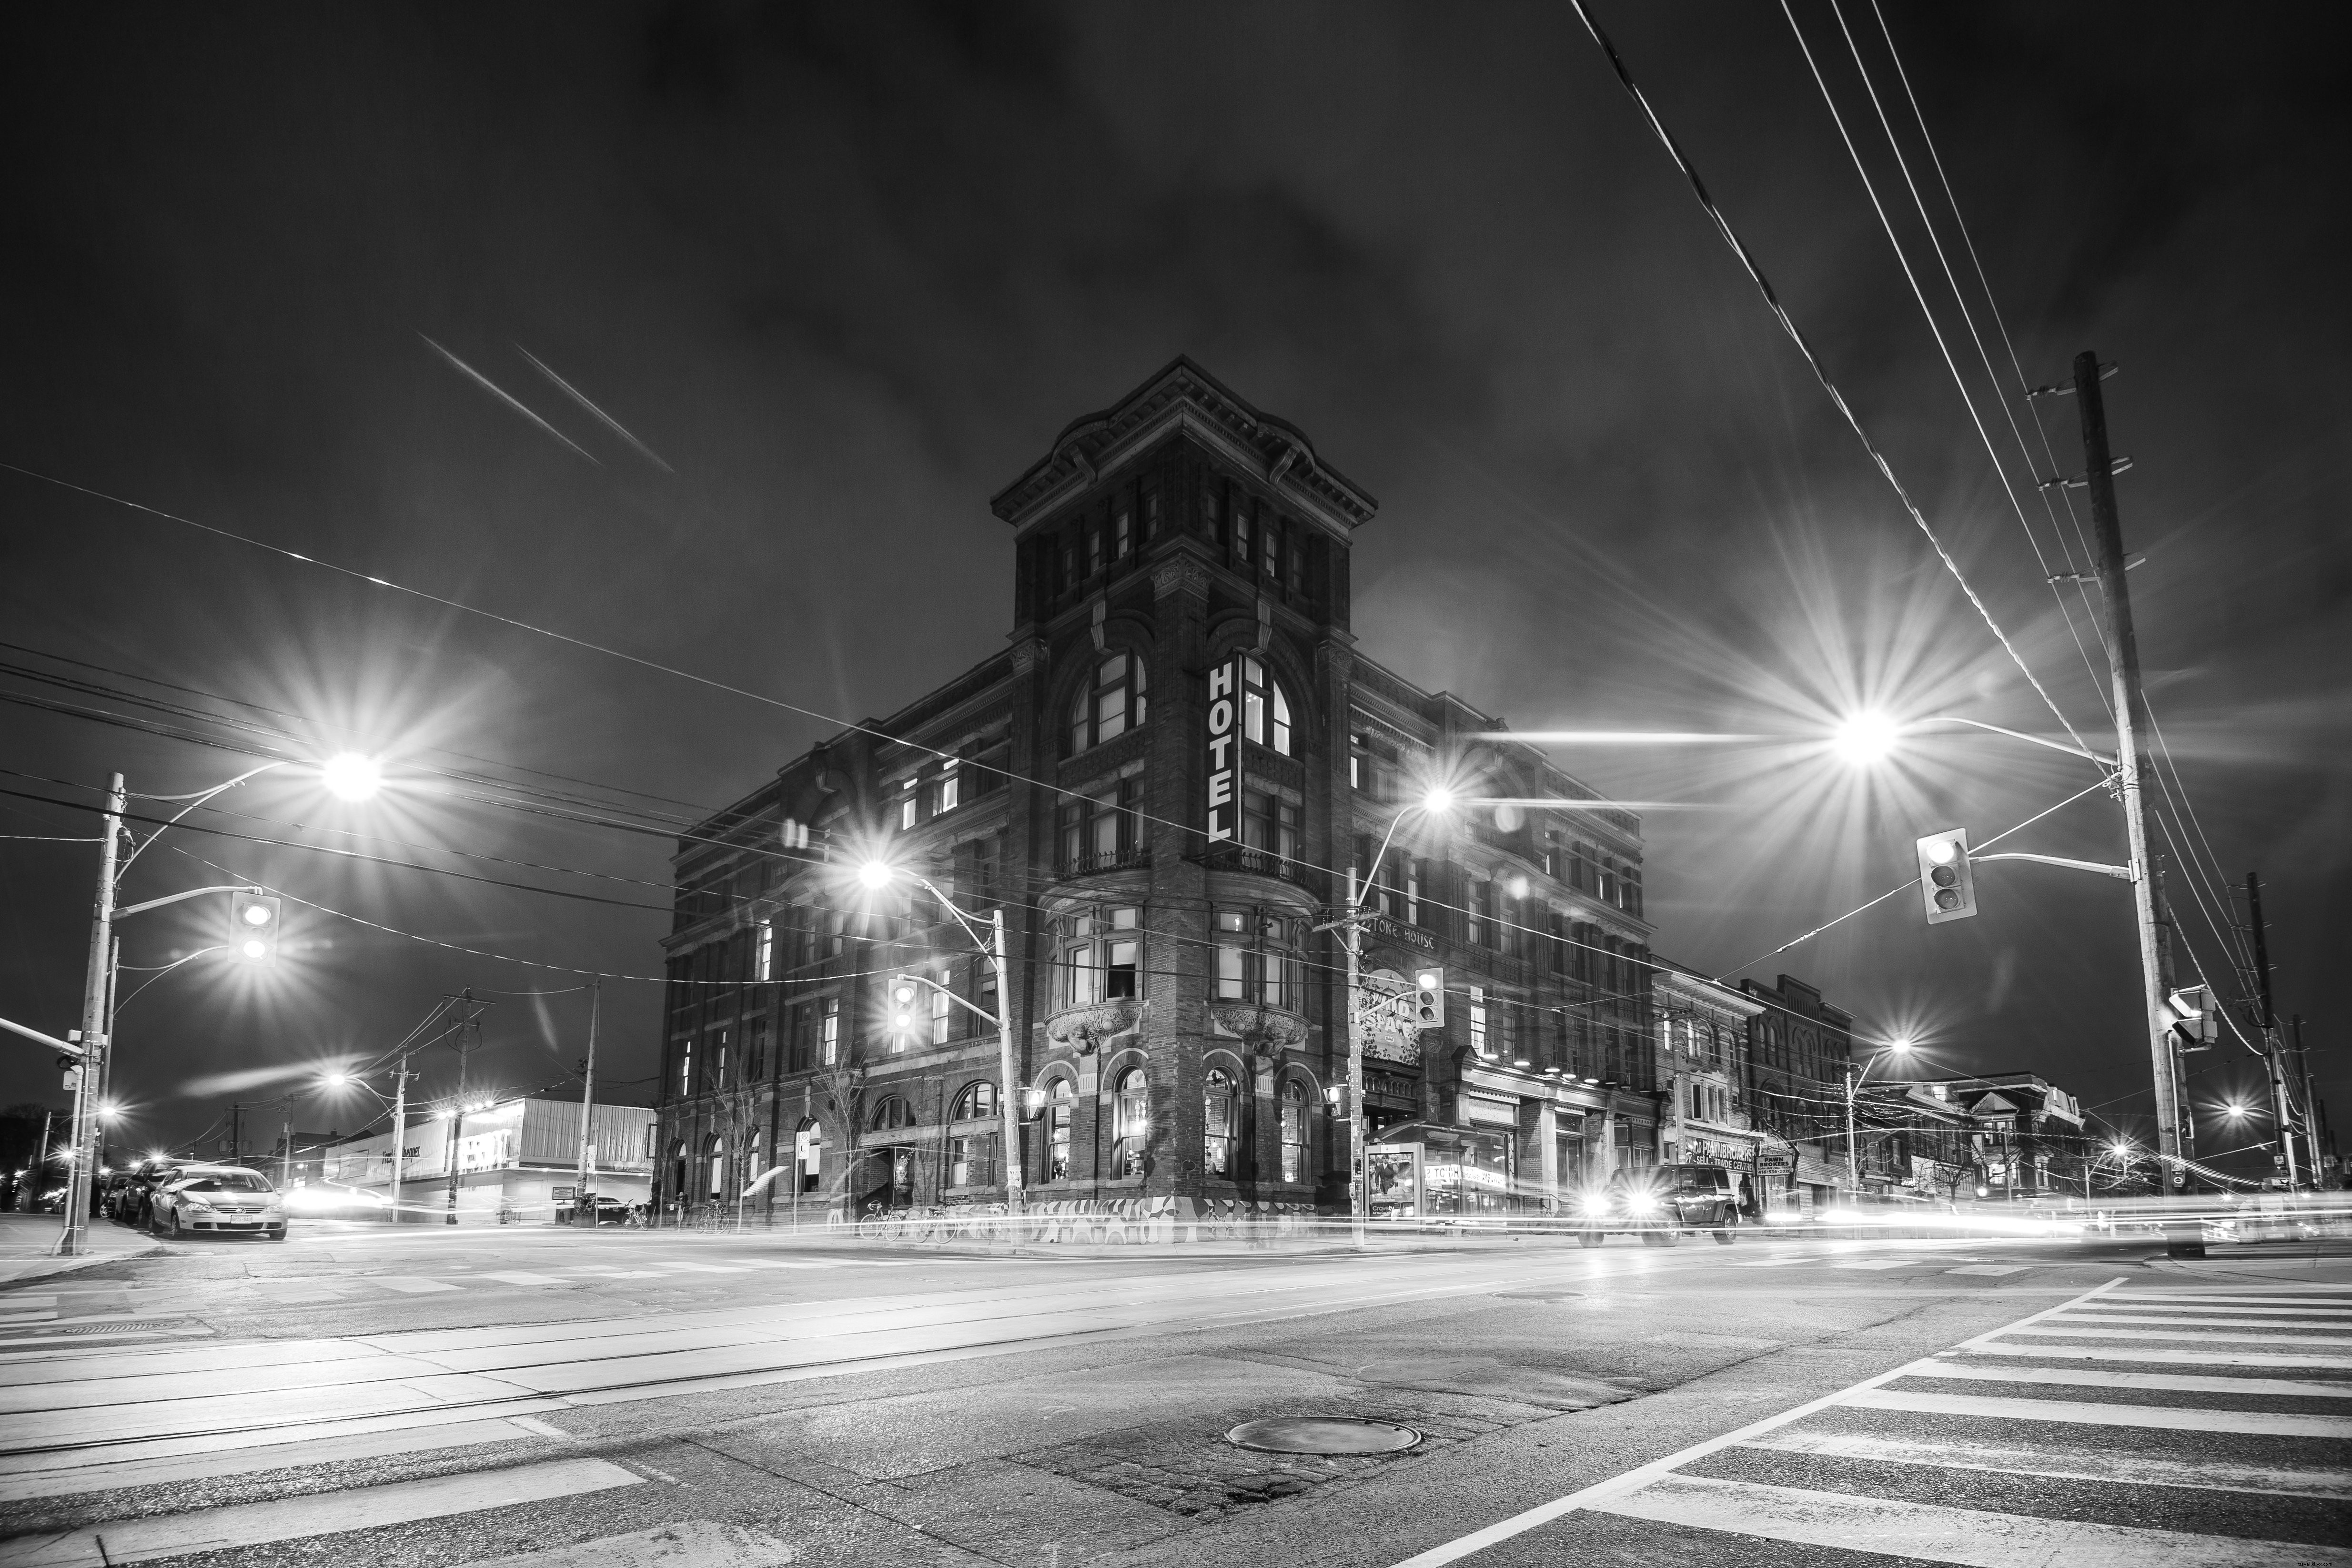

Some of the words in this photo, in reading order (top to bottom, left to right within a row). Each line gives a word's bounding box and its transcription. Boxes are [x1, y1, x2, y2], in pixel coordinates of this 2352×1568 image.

[1209, 662, 1232, 843] HOTEL
[1405, 929, 1434, 949] HOUSE
[1703, 1140, 1752, 1162] PAWNBROKERS
[1696, 1155, 1709, 1164] SELL
[1715, 1158, 1732, 1169] TRADE
[1733, 1161, 1752, 1171] CENTRE
